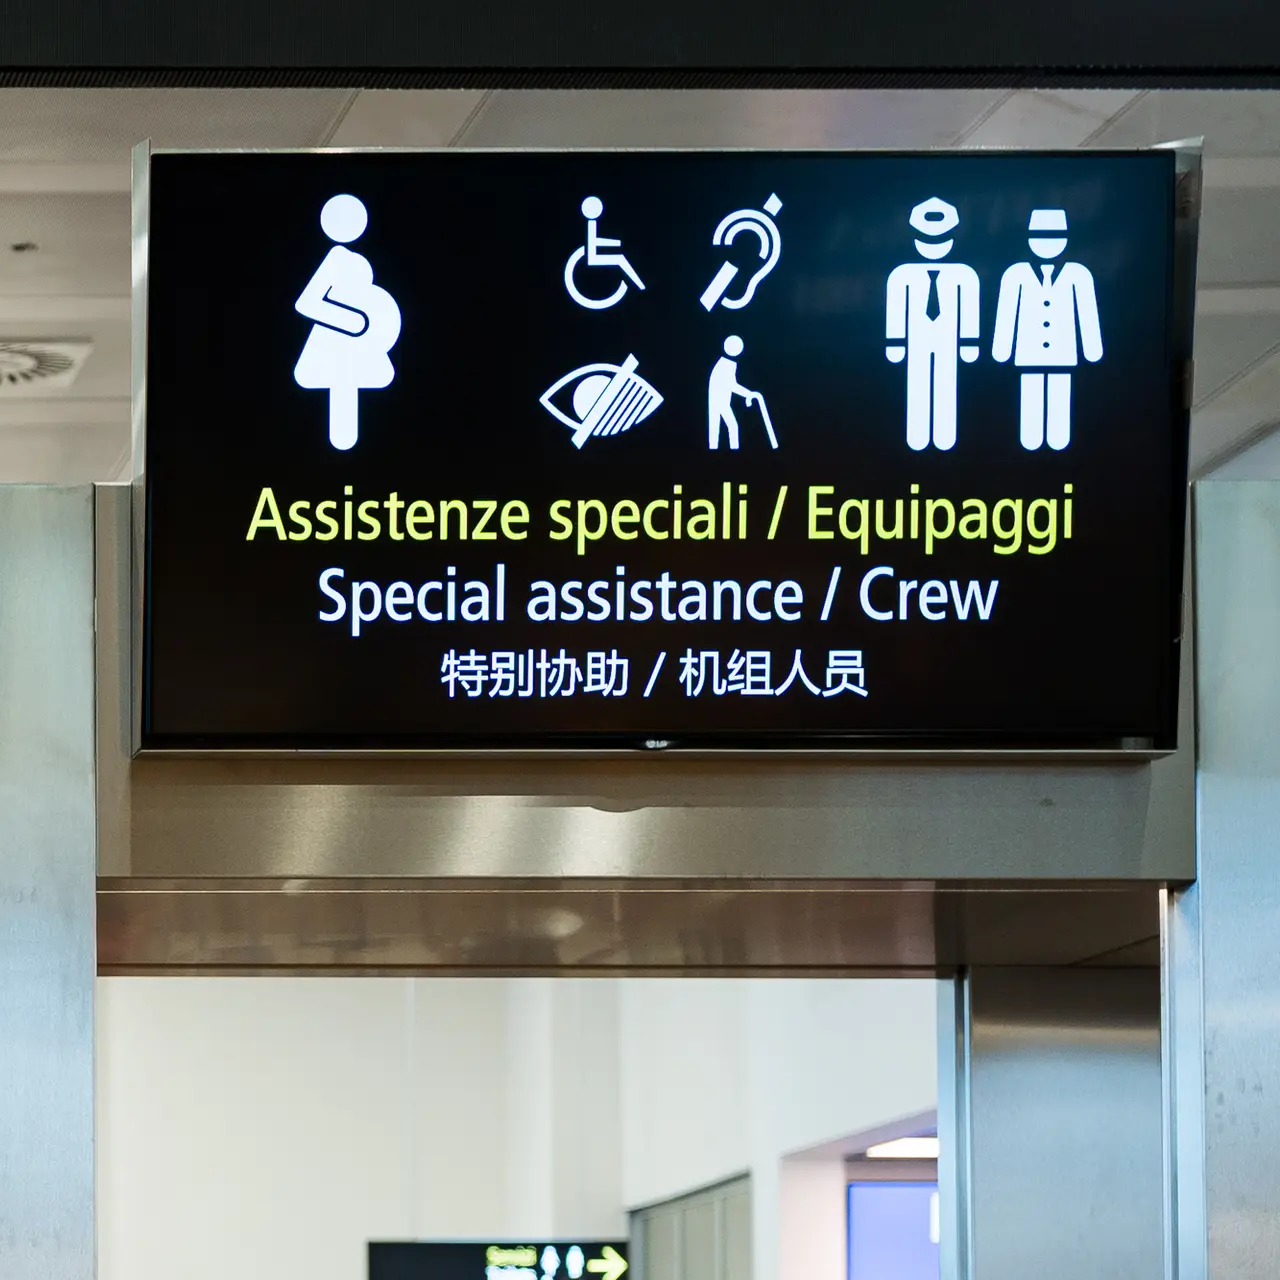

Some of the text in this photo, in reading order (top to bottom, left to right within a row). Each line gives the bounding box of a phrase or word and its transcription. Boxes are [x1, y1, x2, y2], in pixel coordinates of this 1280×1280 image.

[245, 481, 1073, 556] Assistenze speciali / Equipaggi
[319, 563, 999, 637] Special assistance / Crew
[440, 648, 869, 698] 特别协助 / 机组人员
